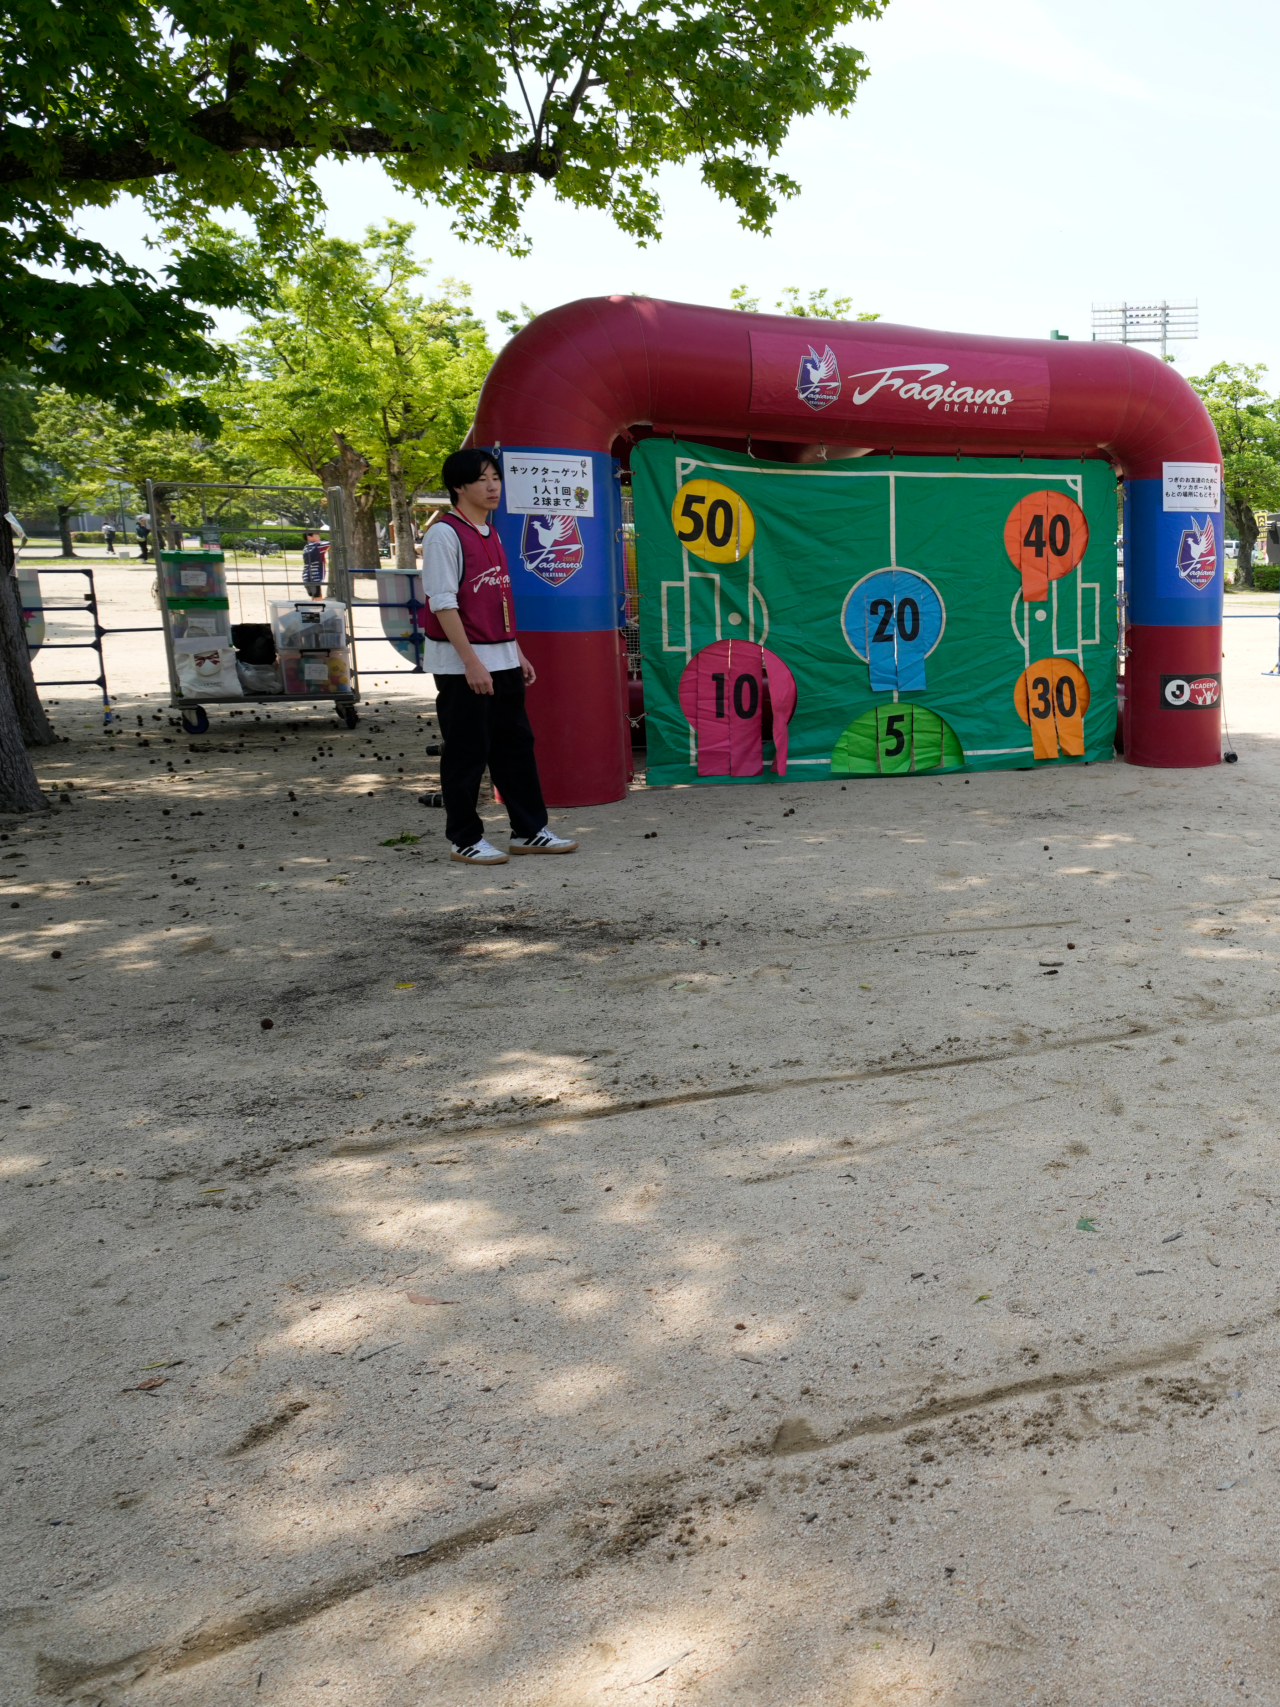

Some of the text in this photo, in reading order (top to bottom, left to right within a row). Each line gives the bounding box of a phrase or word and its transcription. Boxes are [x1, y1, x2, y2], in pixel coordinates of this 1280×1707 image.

[848, 363, 1014, 410] Fagiano
[944, 403, 1008, 415] OKAYAMA
[510, 465, 588, 478] キックターゲット
[533, 485, 571, 496] 1人1回
[533, 496, 571, 507] 2球まで
[678, 493, 733, 548] 50
[1023, 514, 1071, 558] 40
[869, 597, 920, 643] 20
[711, 673, 759, 720] 10
[1031, 676, 1077, 719] 30
[1190, 681, 1218, 690] ACADEMY
[884, 714, 905, 757] 5
